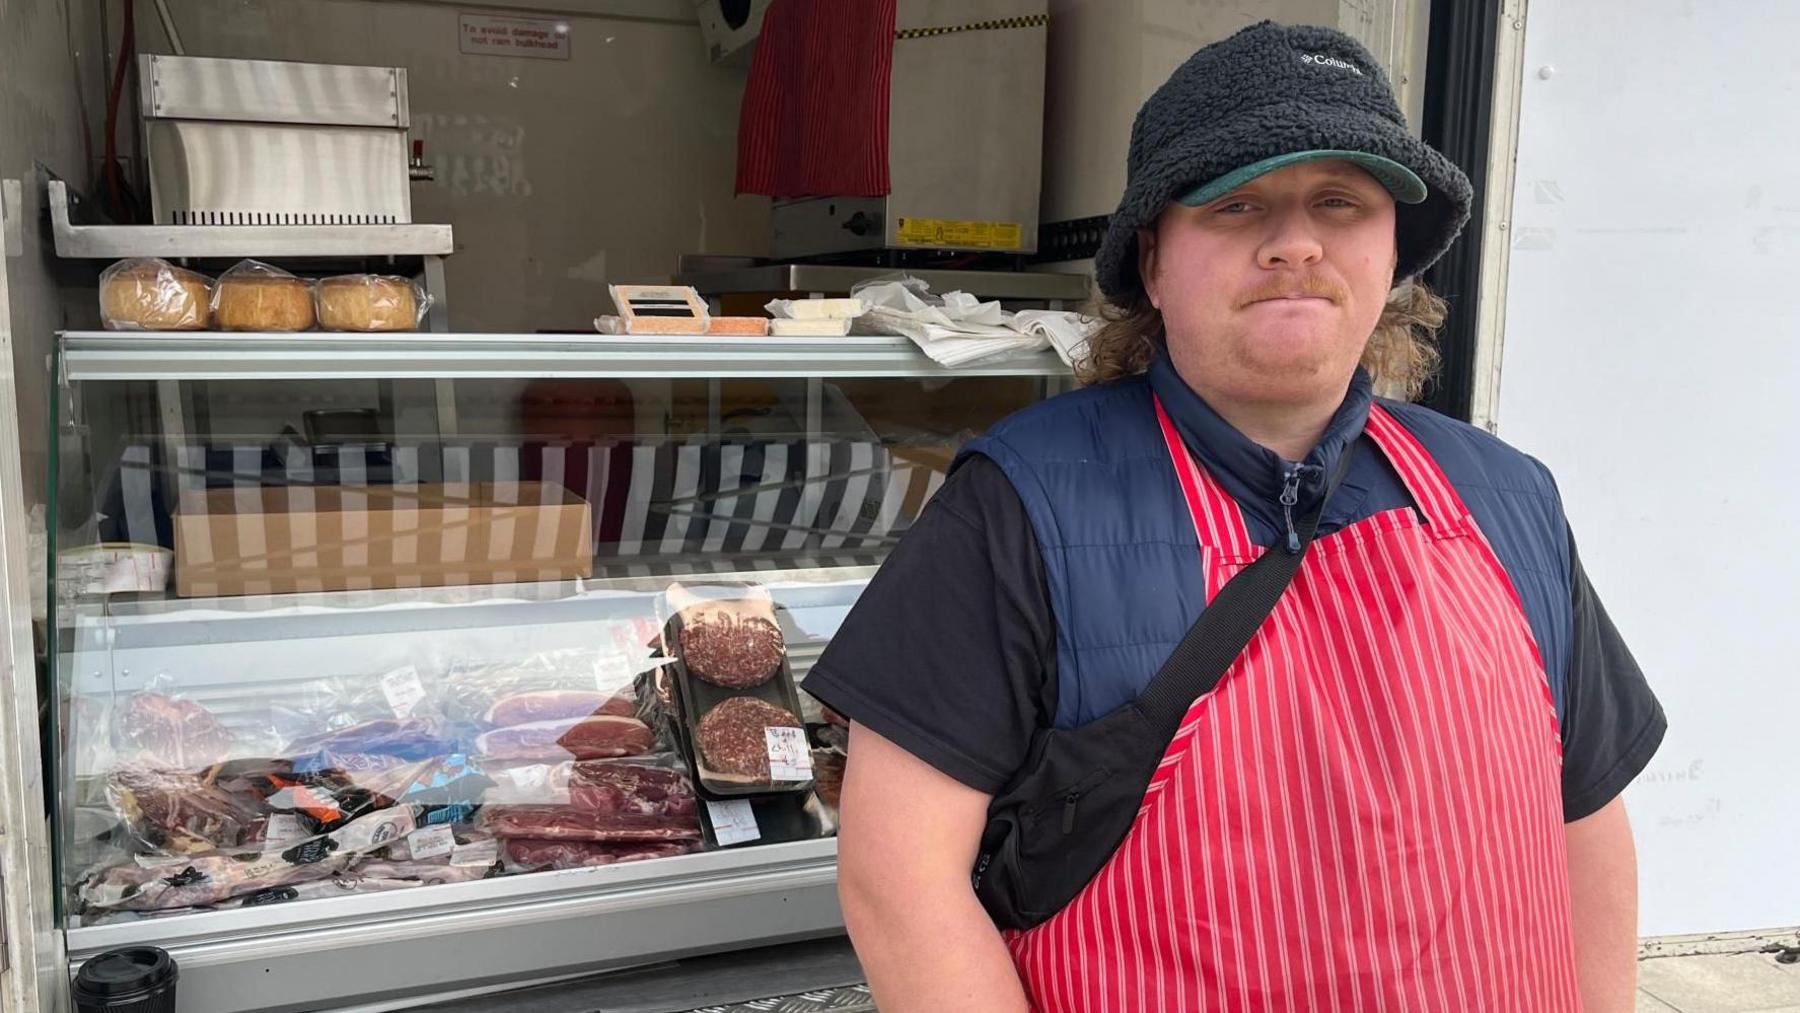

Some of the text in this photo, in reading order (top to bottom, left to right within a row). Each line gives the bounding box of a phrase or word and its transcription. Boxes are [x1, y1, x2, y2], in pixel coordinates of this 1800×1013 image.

[463, 23, 476, 33] To
[481, 26, 508, 35] avoid
[512, 27, 549, 40] damage
[471, 36, 559, 49] not ram bulkhead
